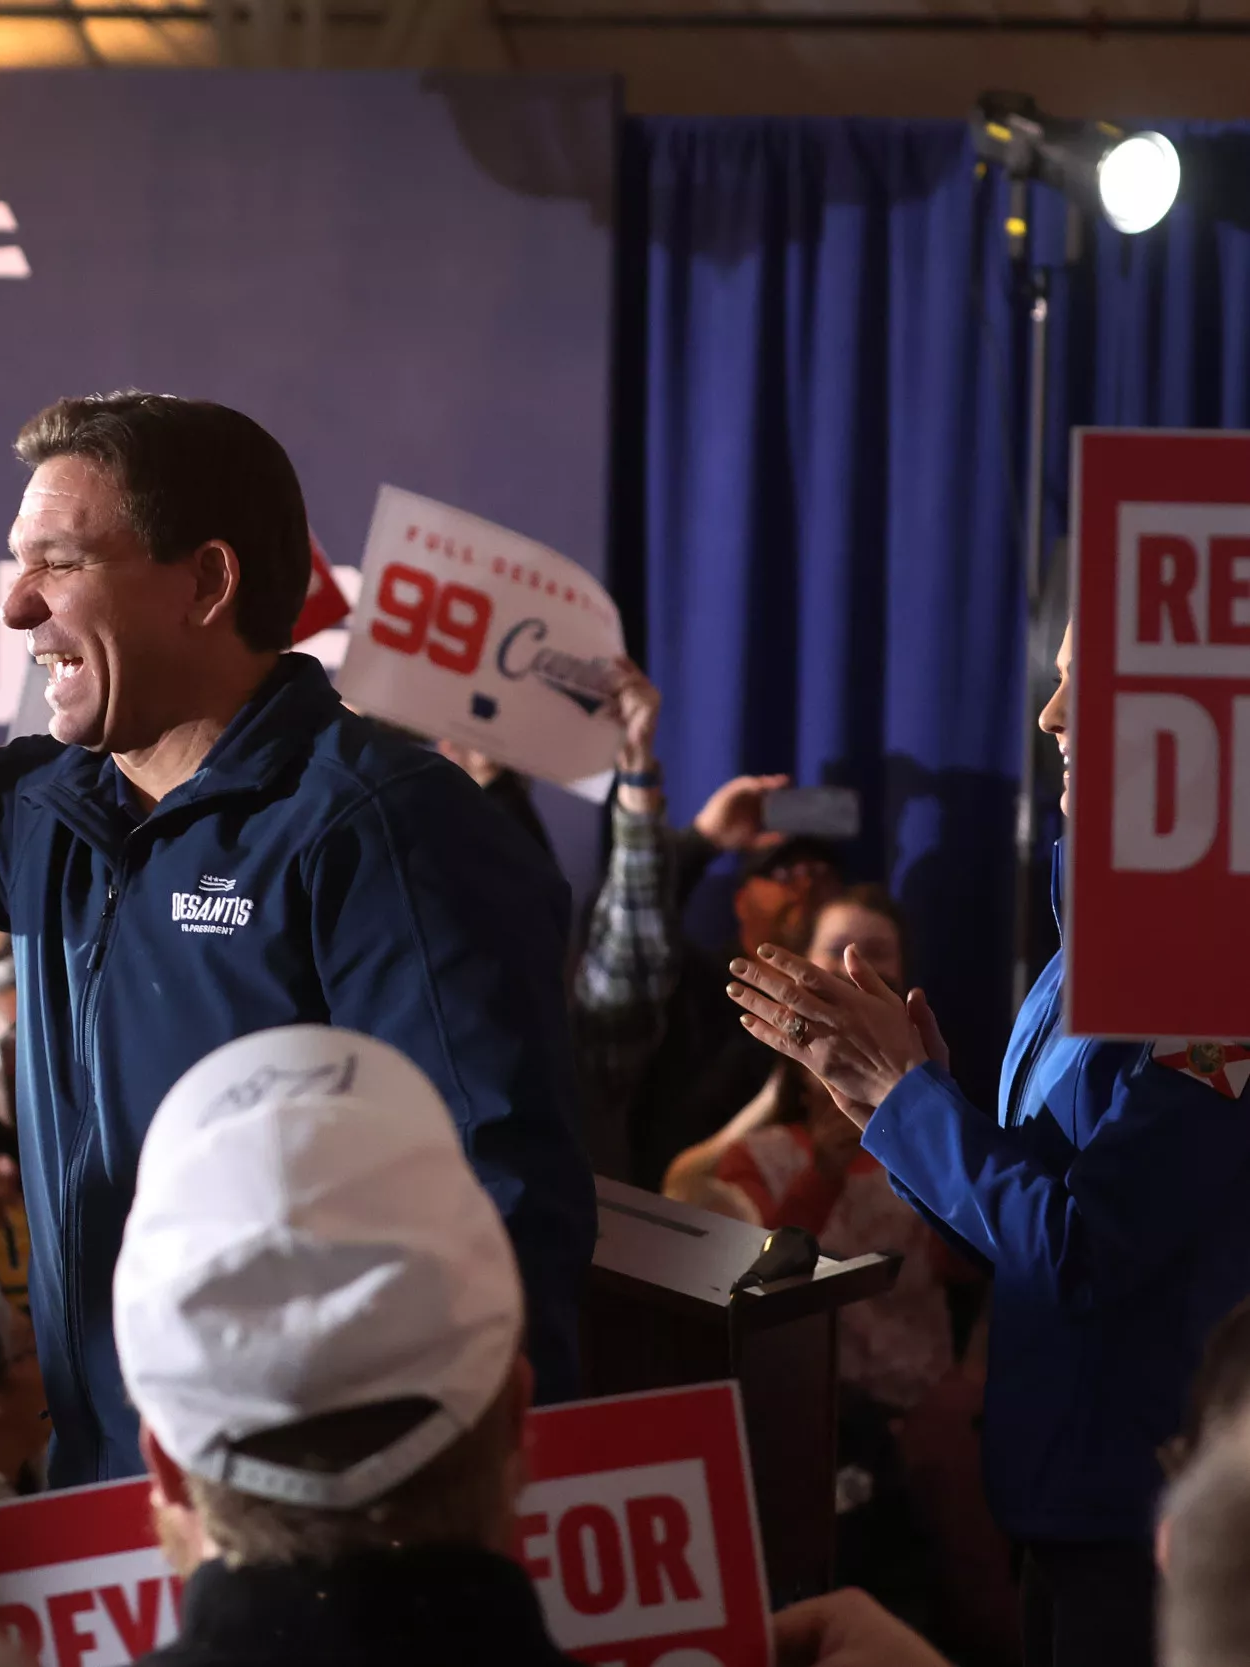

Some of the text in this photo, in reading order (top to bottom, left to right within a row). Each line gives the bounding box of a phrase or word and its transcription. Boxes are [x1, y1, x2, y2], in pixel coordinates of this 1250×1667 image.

[369, 561, 494, 677] 99
[172, 892, 254, 926] DESANTIS
[189, 924, 235, 935] PRESIDENT
[513, 1494, 703, 1617] FOR
